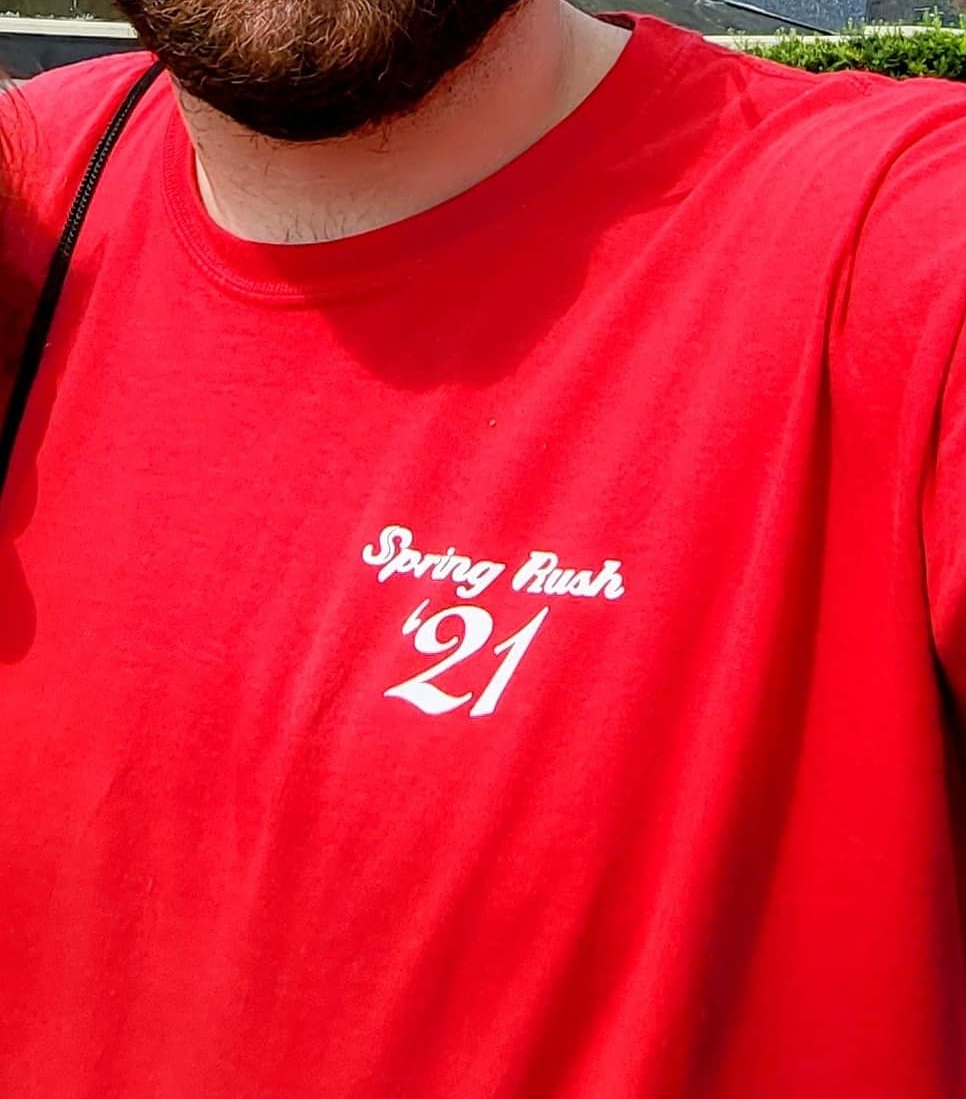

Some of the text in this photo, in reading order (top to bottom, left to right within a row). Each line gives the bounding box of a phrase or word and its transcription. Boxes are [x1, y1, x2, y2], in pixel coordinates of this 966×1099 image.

[362, 525, 626, 601] Spring Rush
[383, 599, 550, 718] '21
